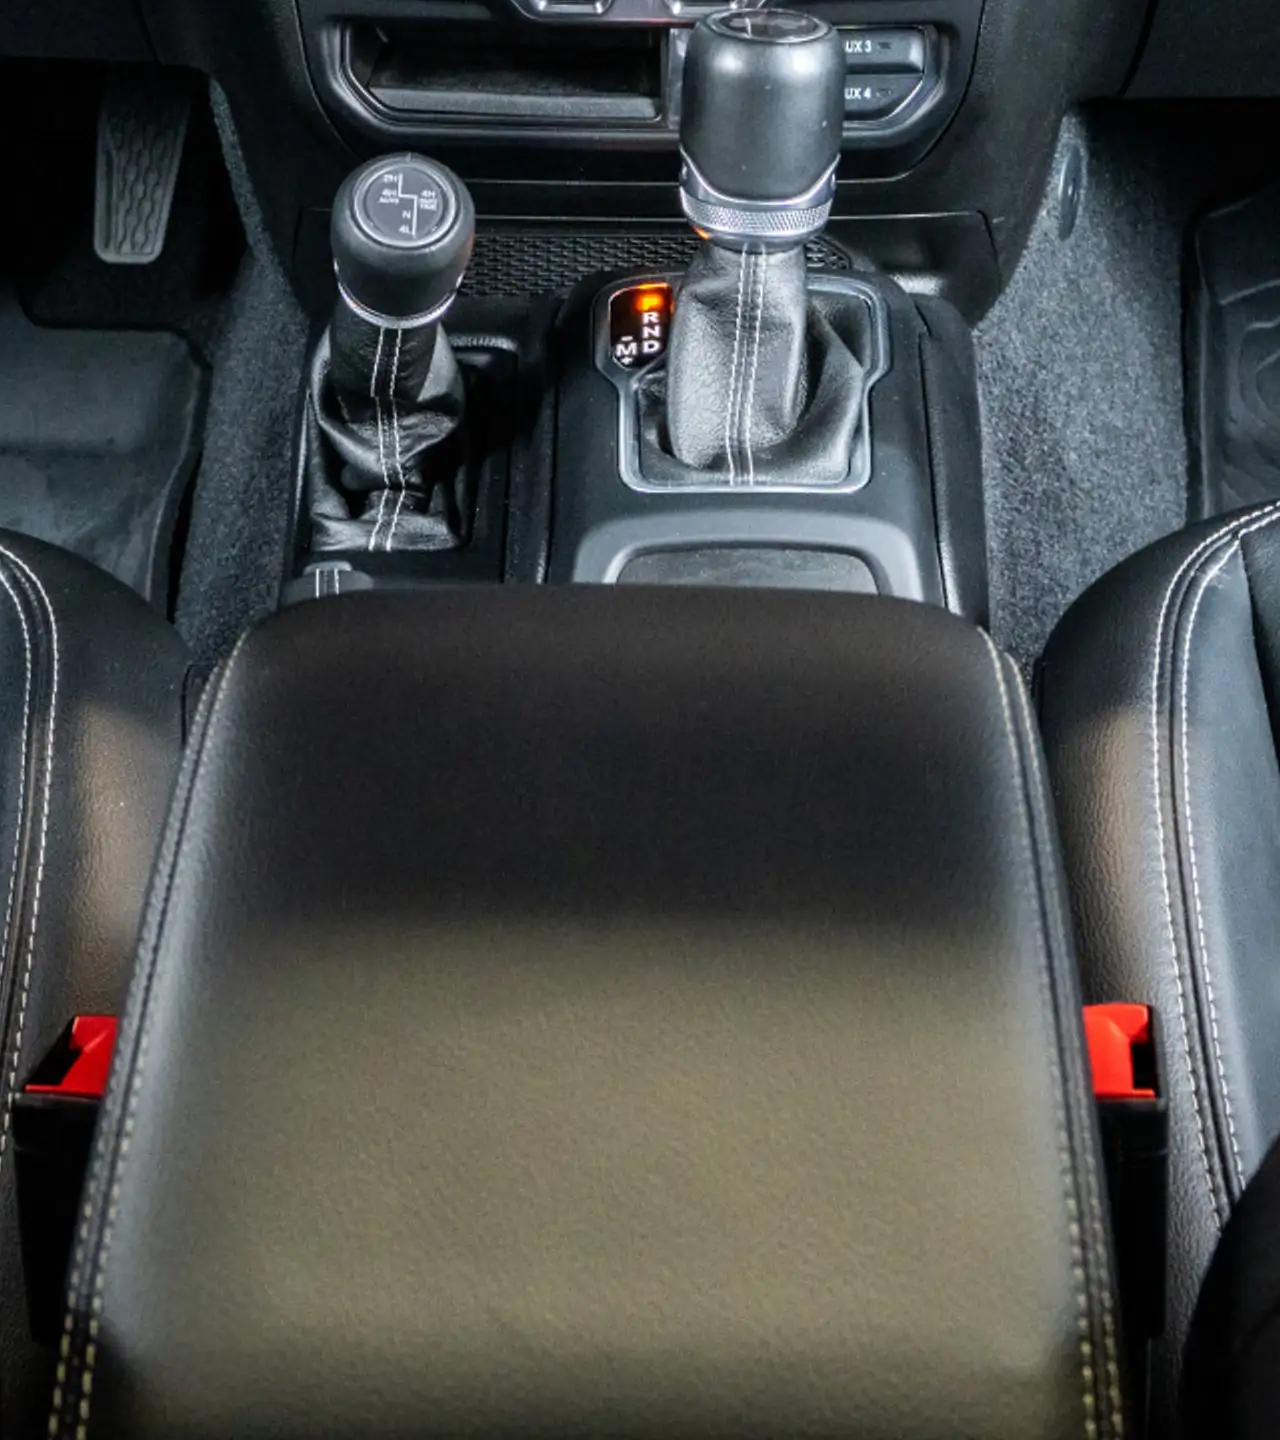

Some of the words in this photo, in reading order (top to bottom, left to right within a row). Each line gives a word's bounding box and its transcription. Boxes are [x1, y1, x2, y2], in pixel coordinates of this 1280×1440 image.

[845, 40, 862, 52] UX
[864, 40, 872, 52] 3
[845, 88, 862, 100] UX
[864, 88, 872, 100] 4
[402, 210, 411, 219] N
[399, 225, 410, 234] 4L
[643, 311, 660, 324] R
[643, 325, 660, 338] N
[616, 342, 637, 357] M
[643, 340, 660, 353] D
